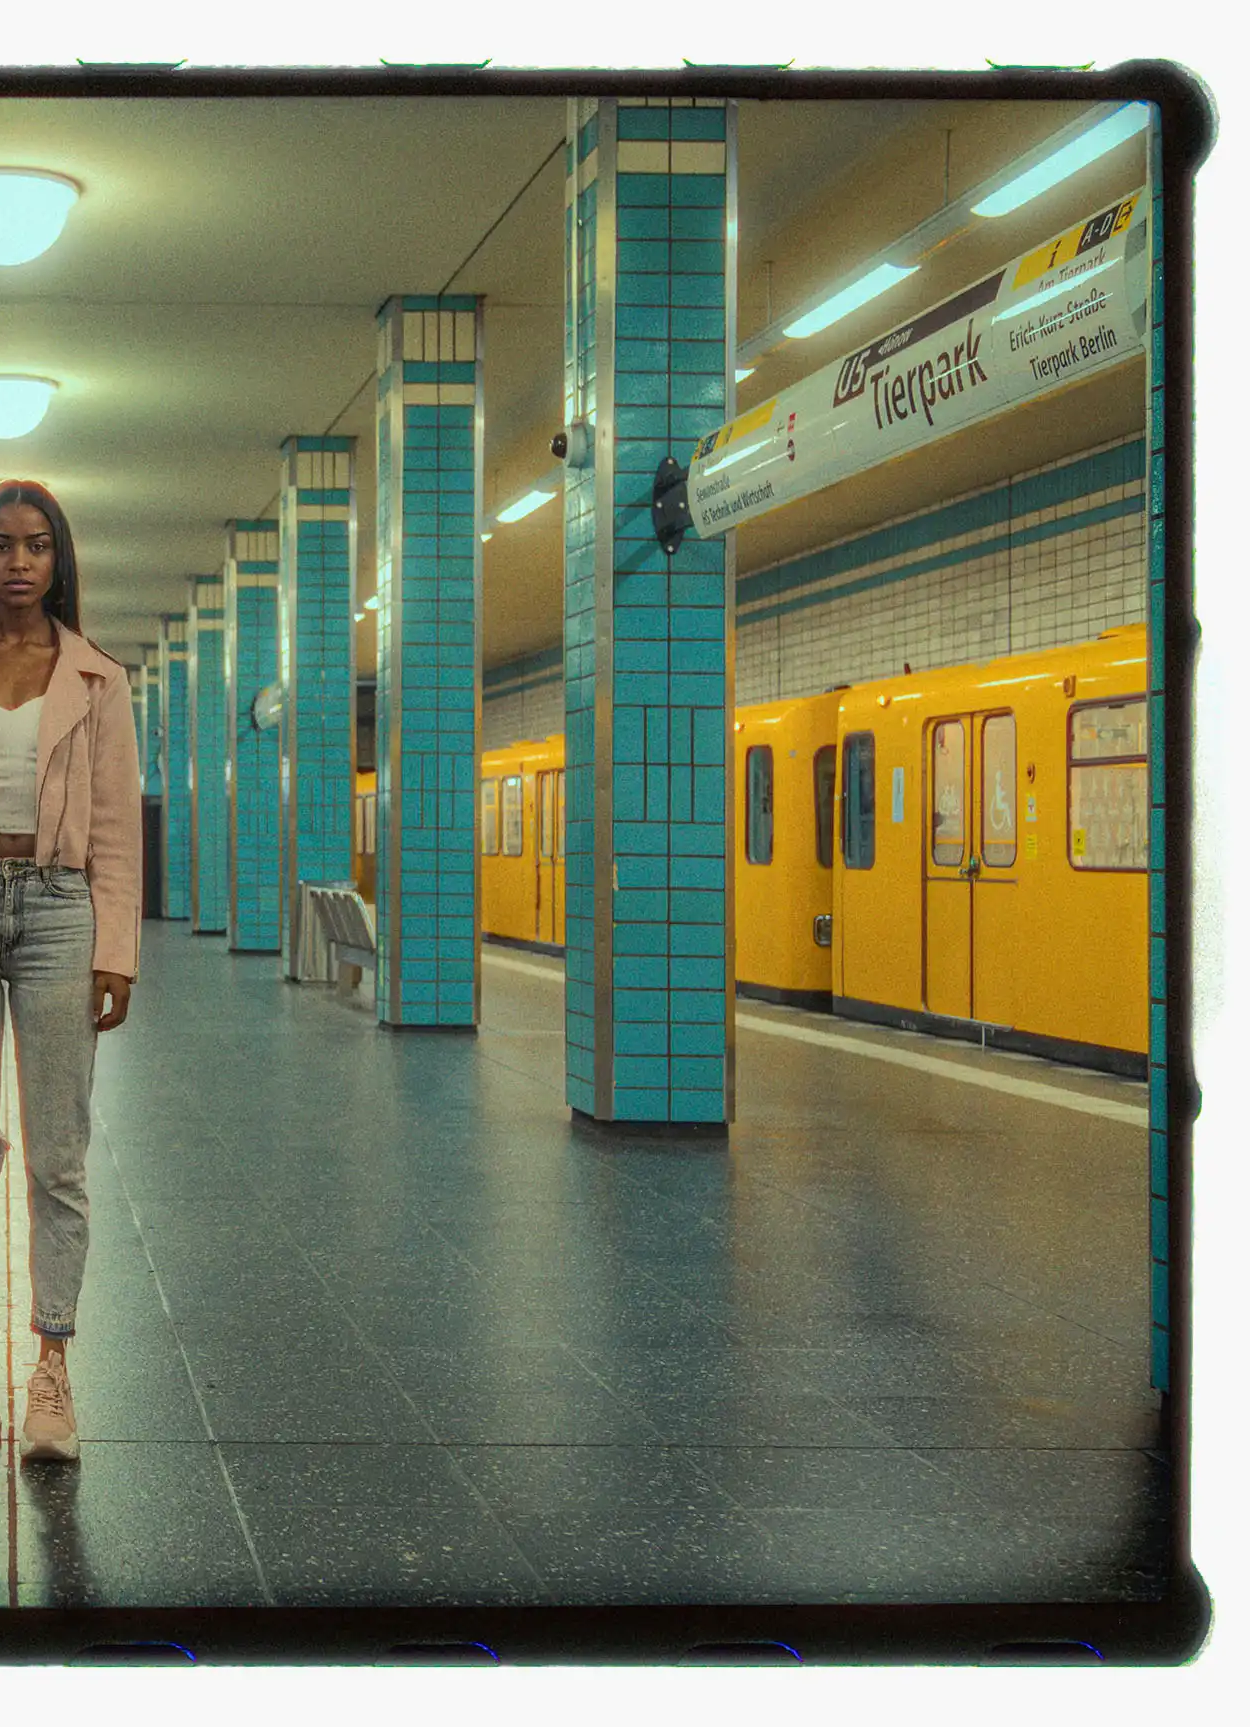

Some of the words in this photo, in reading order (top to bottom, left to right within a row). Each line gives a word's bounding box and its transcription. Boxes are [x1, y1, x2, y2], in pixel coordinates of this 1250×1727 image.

[837, 350, 870, 400] U5
[870, 318, 988, 430] Tierpark
[1029, 340, 1080, 380] Tierpark
[1079, 324, 1118, 359] Berlin
